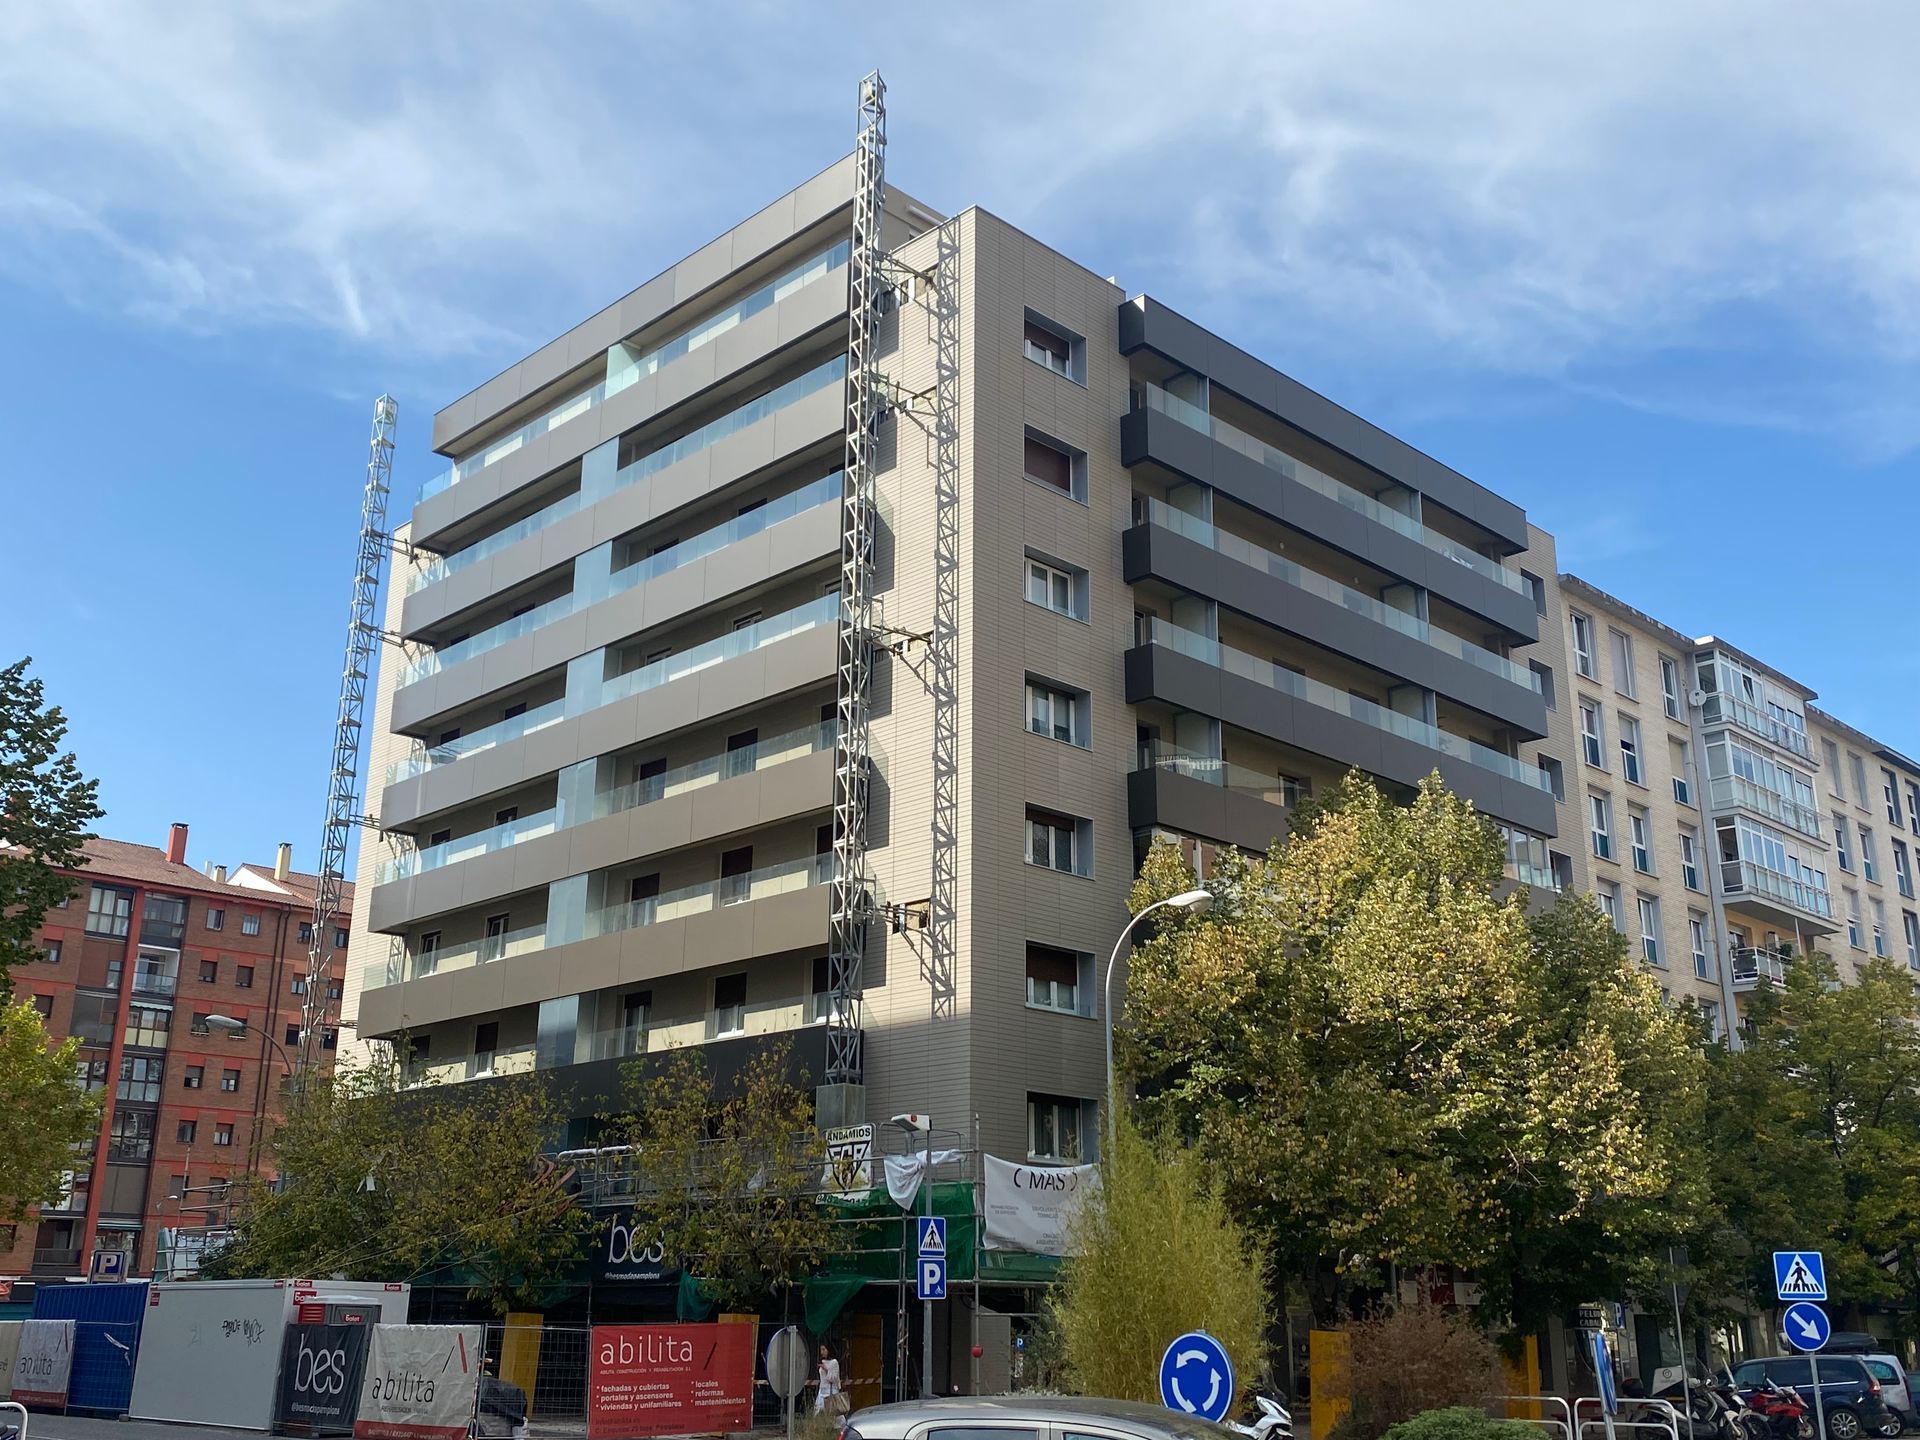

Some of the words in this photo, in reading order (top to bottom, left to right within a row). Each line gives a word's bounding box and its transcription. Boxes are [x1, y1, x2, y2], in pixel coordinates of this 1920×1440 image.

[827, 1127, 871, 1141] ANDAMIOS
[99, 1254, 118, 1274] P
[924, 1263, 941, 1295] P
[600, 1334, 693, 1365] abilita
[295, 1333, 346, 1395] bes
[372, 1370, 435, 1403] abilita
[601, 1385, 632, 1393] fachadas
[639, 1383, 670, 1391] cubiertas
[695, 1380, 719, 1388] locales
[600, 1393, 629, 1403] portales
[635, 1392, 674, 1400] ascensores
[695, 1389, 725, 1397] reformas
[600, 1402, 633, 1411] viviendas
[639, 1400, 682, 1409] unifamiliares
[694, 1397, 746, 1407] mantenimientos
